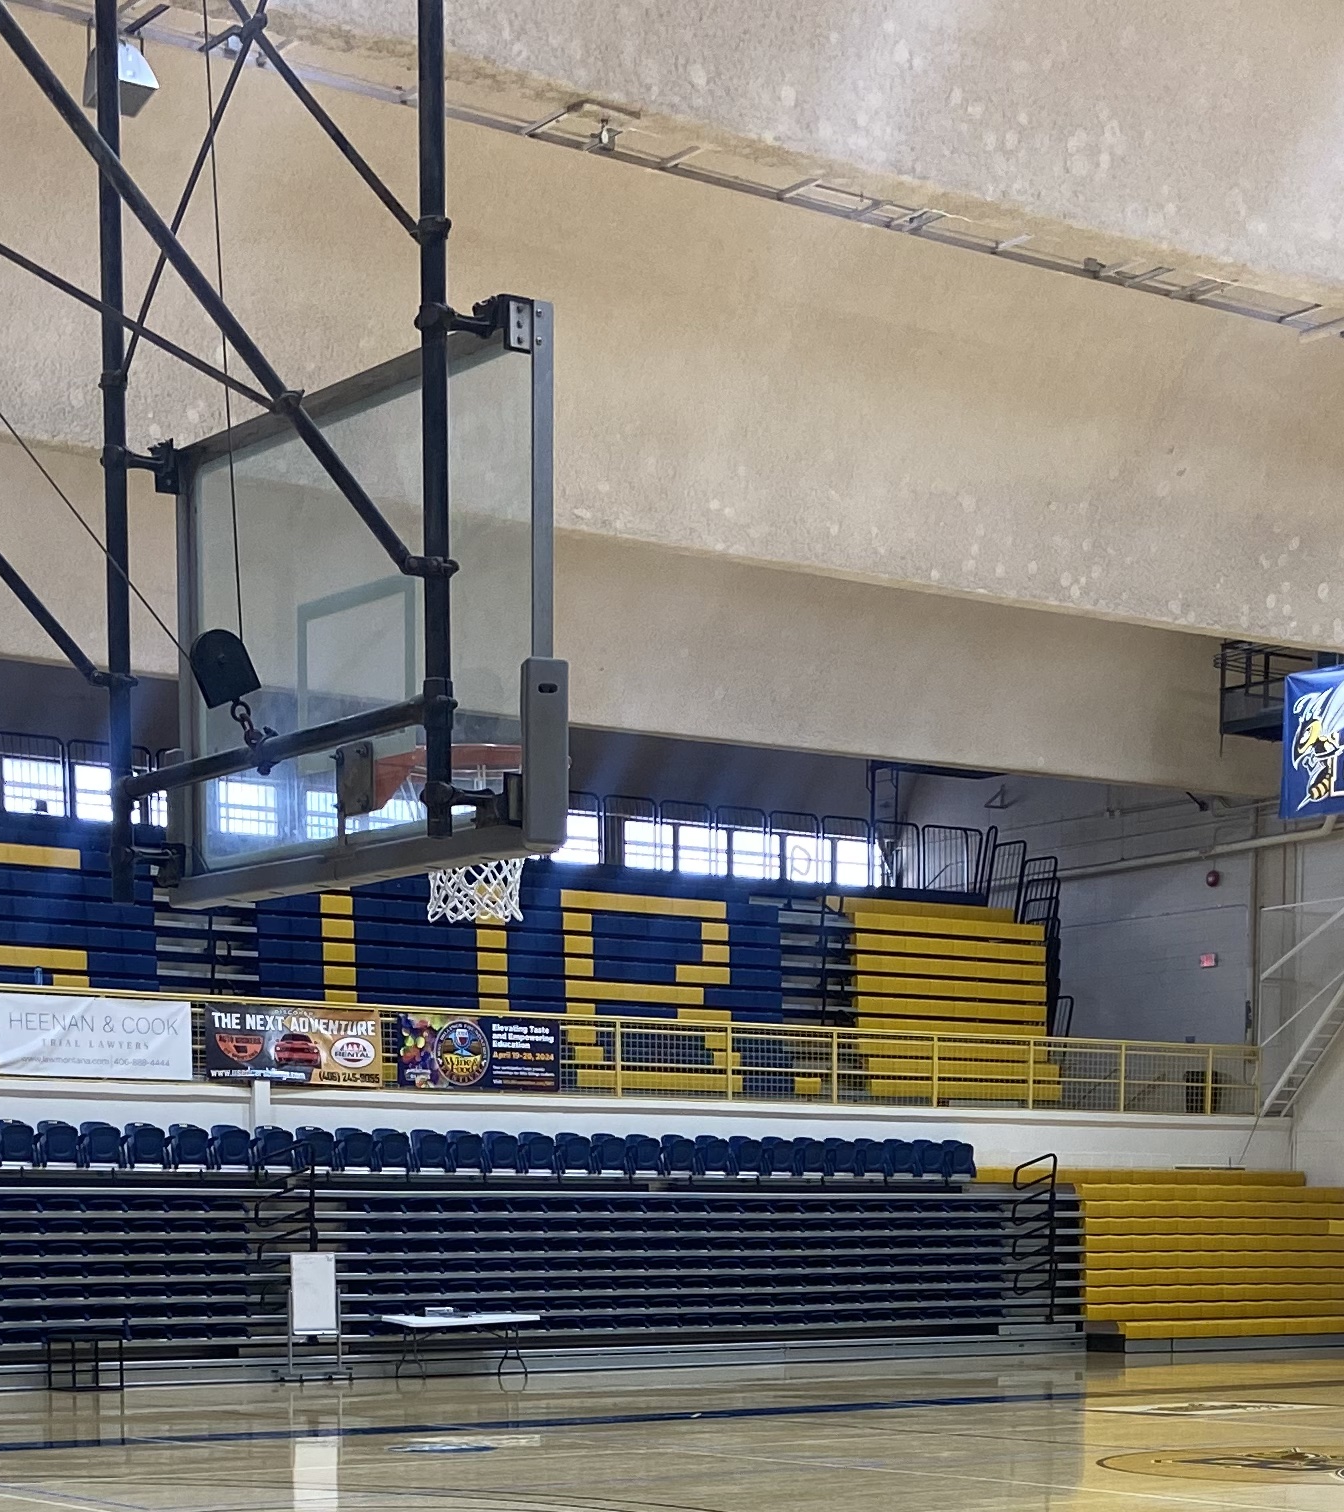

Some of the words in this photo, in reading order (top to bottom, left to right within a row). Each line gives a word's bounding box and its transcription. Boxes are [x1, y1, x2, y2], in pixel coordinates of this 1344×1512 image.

[8, 1012, 95, 1033] HEENAN
[102, 1015, 115, 1033] &
[121, 1016, 179, 1036] COOK
[212, 1012, 241, 1029] THE
[246, 1014, 284, 1031] NEXT
[290, 1016, 376, 1036] ADVENTURE
[42, 1038, 81, 1048] TRIAL
[89, 1040, 149, 1050] LAWYERS
